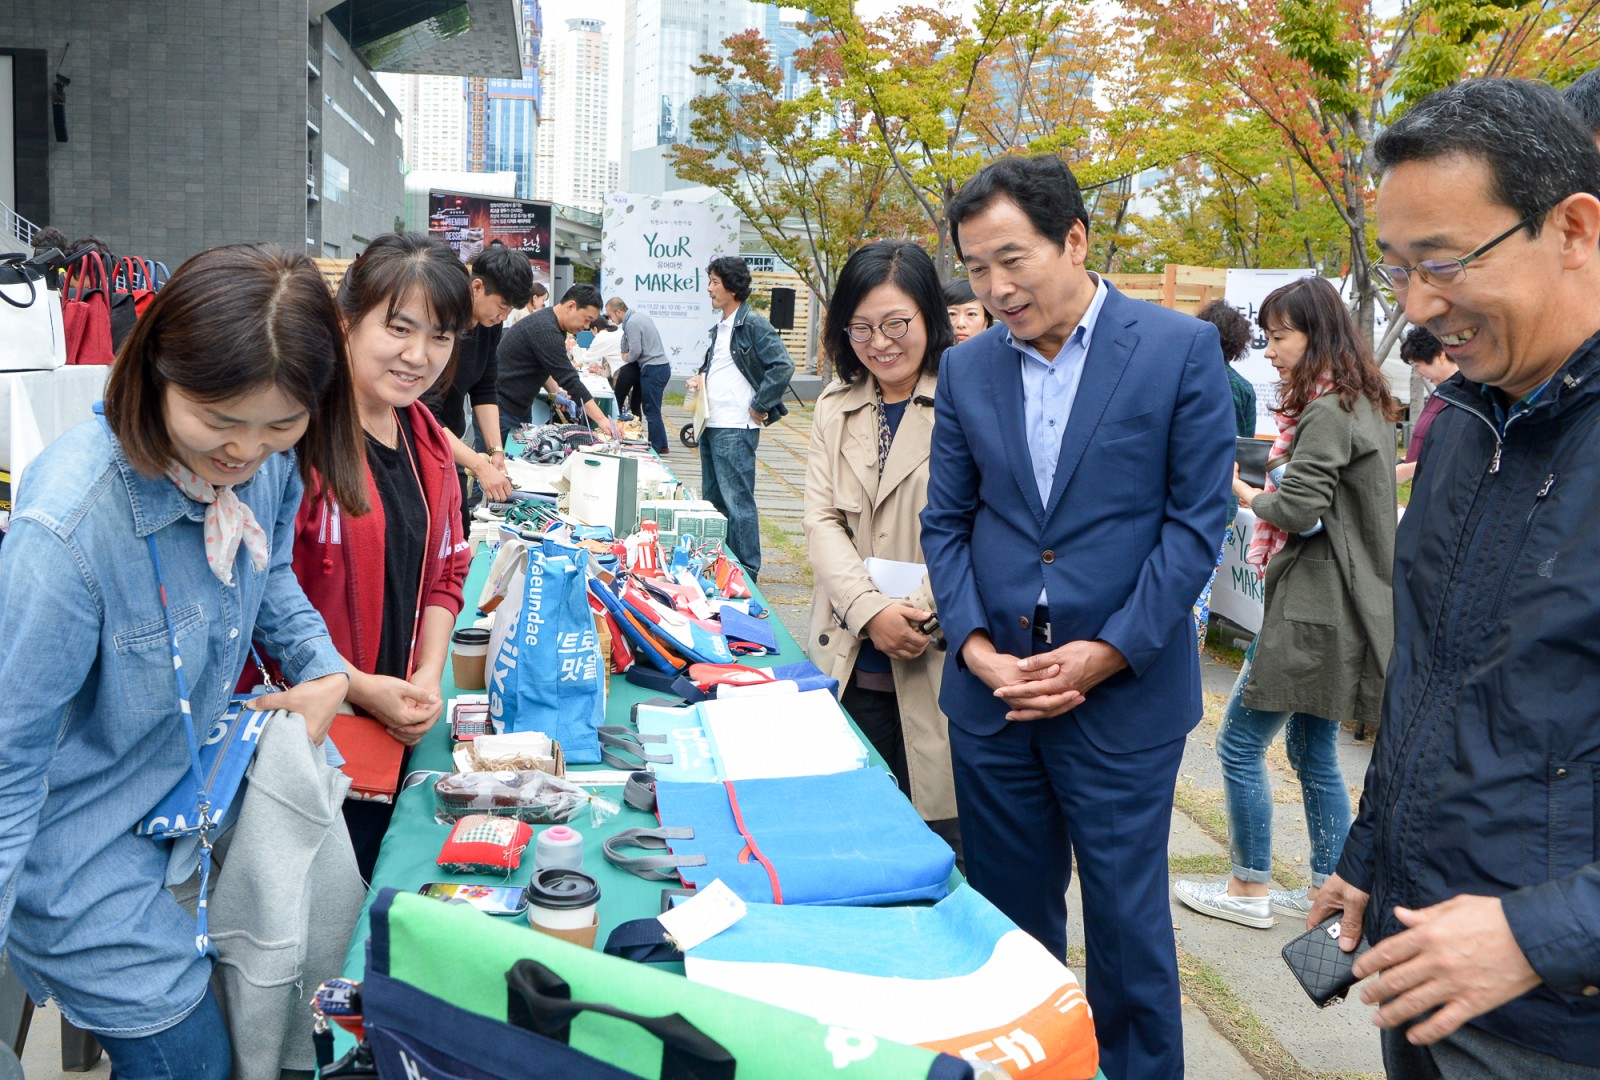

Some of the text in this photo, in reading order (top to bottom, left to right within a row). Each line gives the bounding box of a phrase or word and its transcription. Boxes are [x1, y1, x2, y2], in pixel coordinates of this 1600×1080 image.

[445, 217, 469, 226] PREMIUM
[657, 261, 683, 269] 유어마켓
[525, 551, 547, 647] Haeundae
